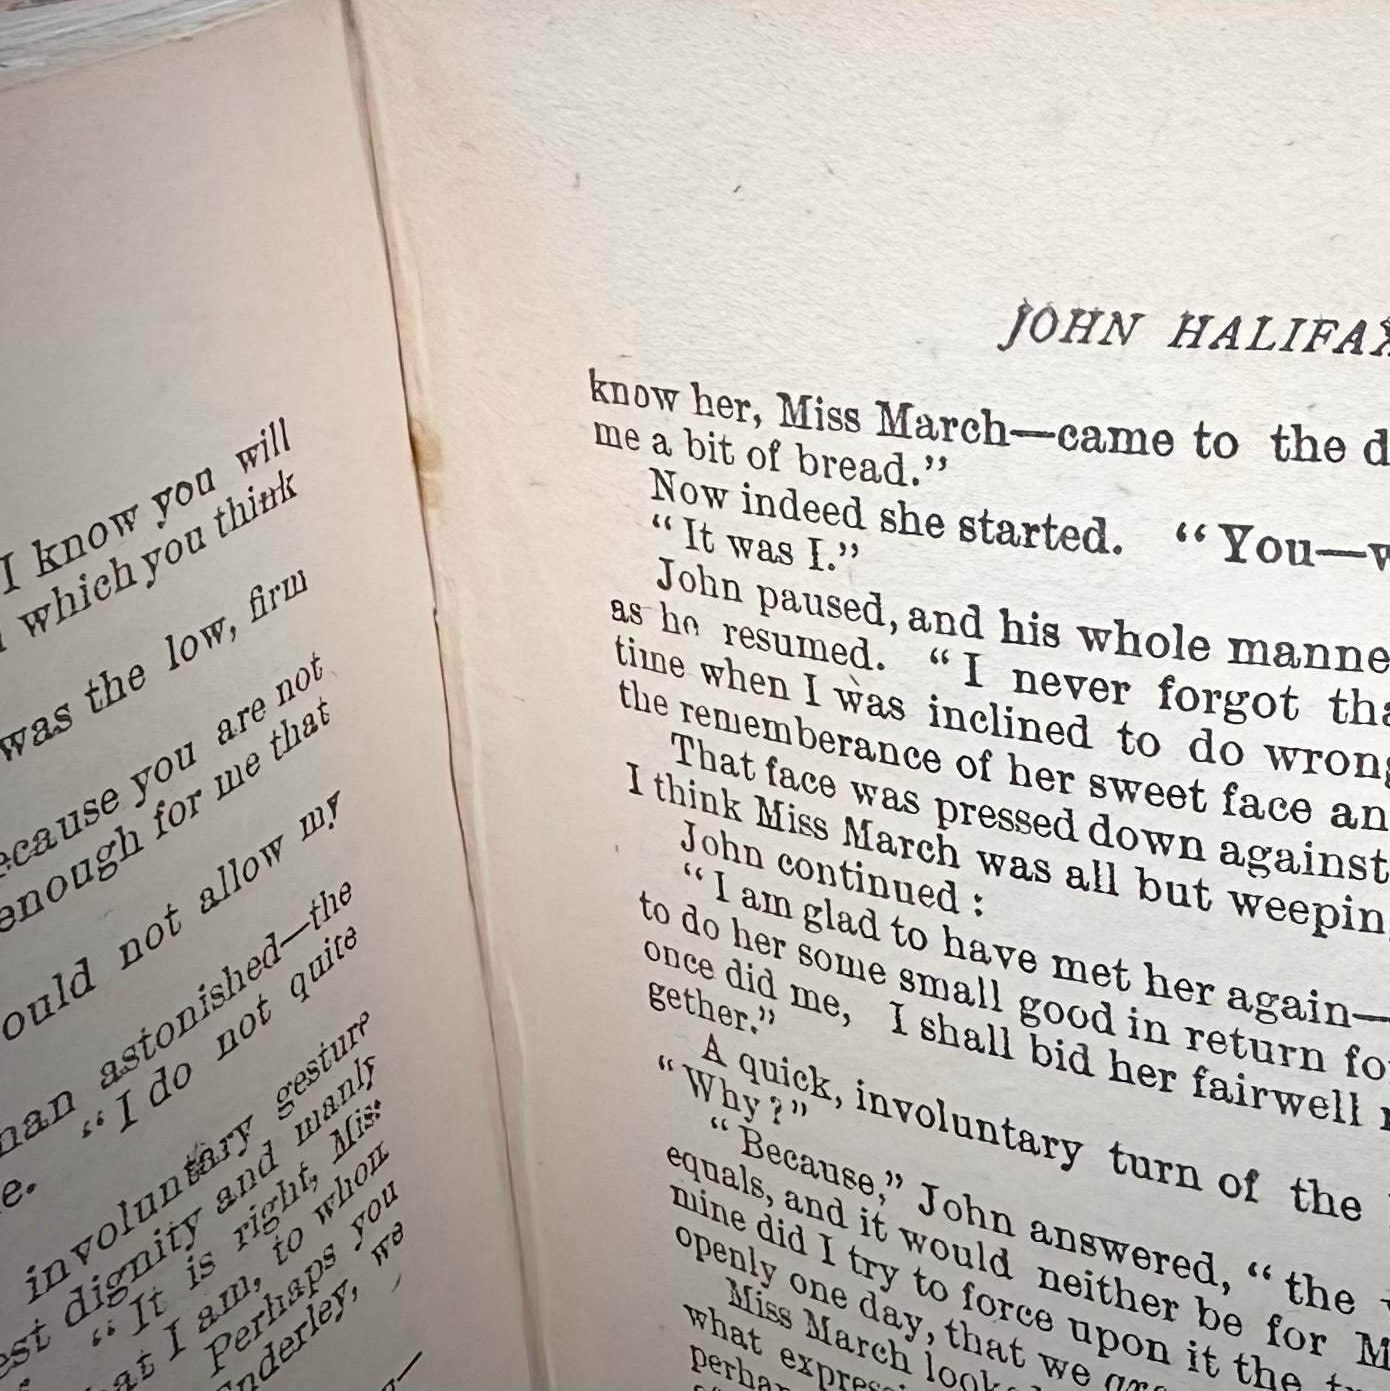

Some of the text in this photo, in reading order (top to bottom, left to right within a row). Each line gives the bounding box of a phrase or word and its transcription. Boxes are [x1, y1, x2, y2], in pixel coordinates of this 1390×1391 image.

[997, 297, 1146, 352] JOHN
[589, 368, 680, 412] know
[690, 381, 762, 429] her,
[776, 392, 861, 433] Miss
[1193, 421, 1239, 459] to
[1270, 424, 1346, 463] the
[594, 422, 947, 487] me a bit of bread.”
[18, 470, 297, 638] which you think
[31, 504, 138, 577] know
[151, 467, 216, 529] you
[235, 417, 290, 474] will
[649, 467, 729, 509] Now
[741, 482, 867, 530] indeed
[880, 500, 945, 539] she
[959, 509, 1122, 555] started.
[652, 514, 858, 571] “It was I.”
[0, 570, 308, 762] was the low, firm
[611, 599, 643, 625] as
[723, 623, 885, 670] resumed.
[1012, 669, 1131, 705] never
[1158, 674, 1299, 725] forgot
[657, 557, 743, 603] John
[757, 585, 897, 635] paused,
[908, 604, 984, 639] and
[999, 608, 1060, 648] his
[1076, 619, 1210, 662] whole
[130, 741, 197, 808] you
[218, 698, 265, 745] are
[276, 652, 322, 707] not
[615, 635, 685, 678] time
[700, 657, 791, 700] when
[803, 673, 821, 707] I
[833, 674, 906, 721] was
[929, 694, 1093, 749] inclined
[1117, 721, 1161, 758] to
[1189, 728, 1244, 766] do
[619, 680, 668, 716] the
[680, 701, 941, 773] rememberance
[956, 749, 993, 782] of
[1007, 752, 1075, 794] her
[1090, 774, 1207, 813] sweet
[1222, 782, 1312, 824] face
[0, 696, 329, 933] enough for me that
[119, 903, 181, 970] not
[200, 834, 283, 914] allow
[299, 790, 340, 842] my
[149, 1063, 192, 1107] do
[217, 994, 271, 1061] not
[639, 890, 670, 924] to
[682, 904, 719, 940] do
[731, 917, 786, 959] her
[799, 943, 886, 985] some
[900, 968, 1003, 1012] small
[1019, 996, 1116, 1036] good
[1127, 1007, 1170, 1045] in
[1184, 1027, 1326, 1072] return
[701, 1033, 727, 1067] A
[739, 1053, 842, 1109] quick,
[856, 1079, 1084, 1172] involuntary
[1108, 1141, 1203, 1191] turn
[1218, 1169, 1260, 1203] of
[1290, 1177, 1362, 1221] the
[25, 1114, 253, 1305] involuntary
[65, 1207, 202, 1328] dignity
[216, 1139, 279, 1214] and
[186, 1251, 216, 1290] is
[233, 1161, 318, 1252] right,
[204, 1180, 398, 1378] Perhaps you
[164, 1318, 187, 1361] I
[198, 1276, 262, 1334] am,
[272, 1227, 304, 1266] to
